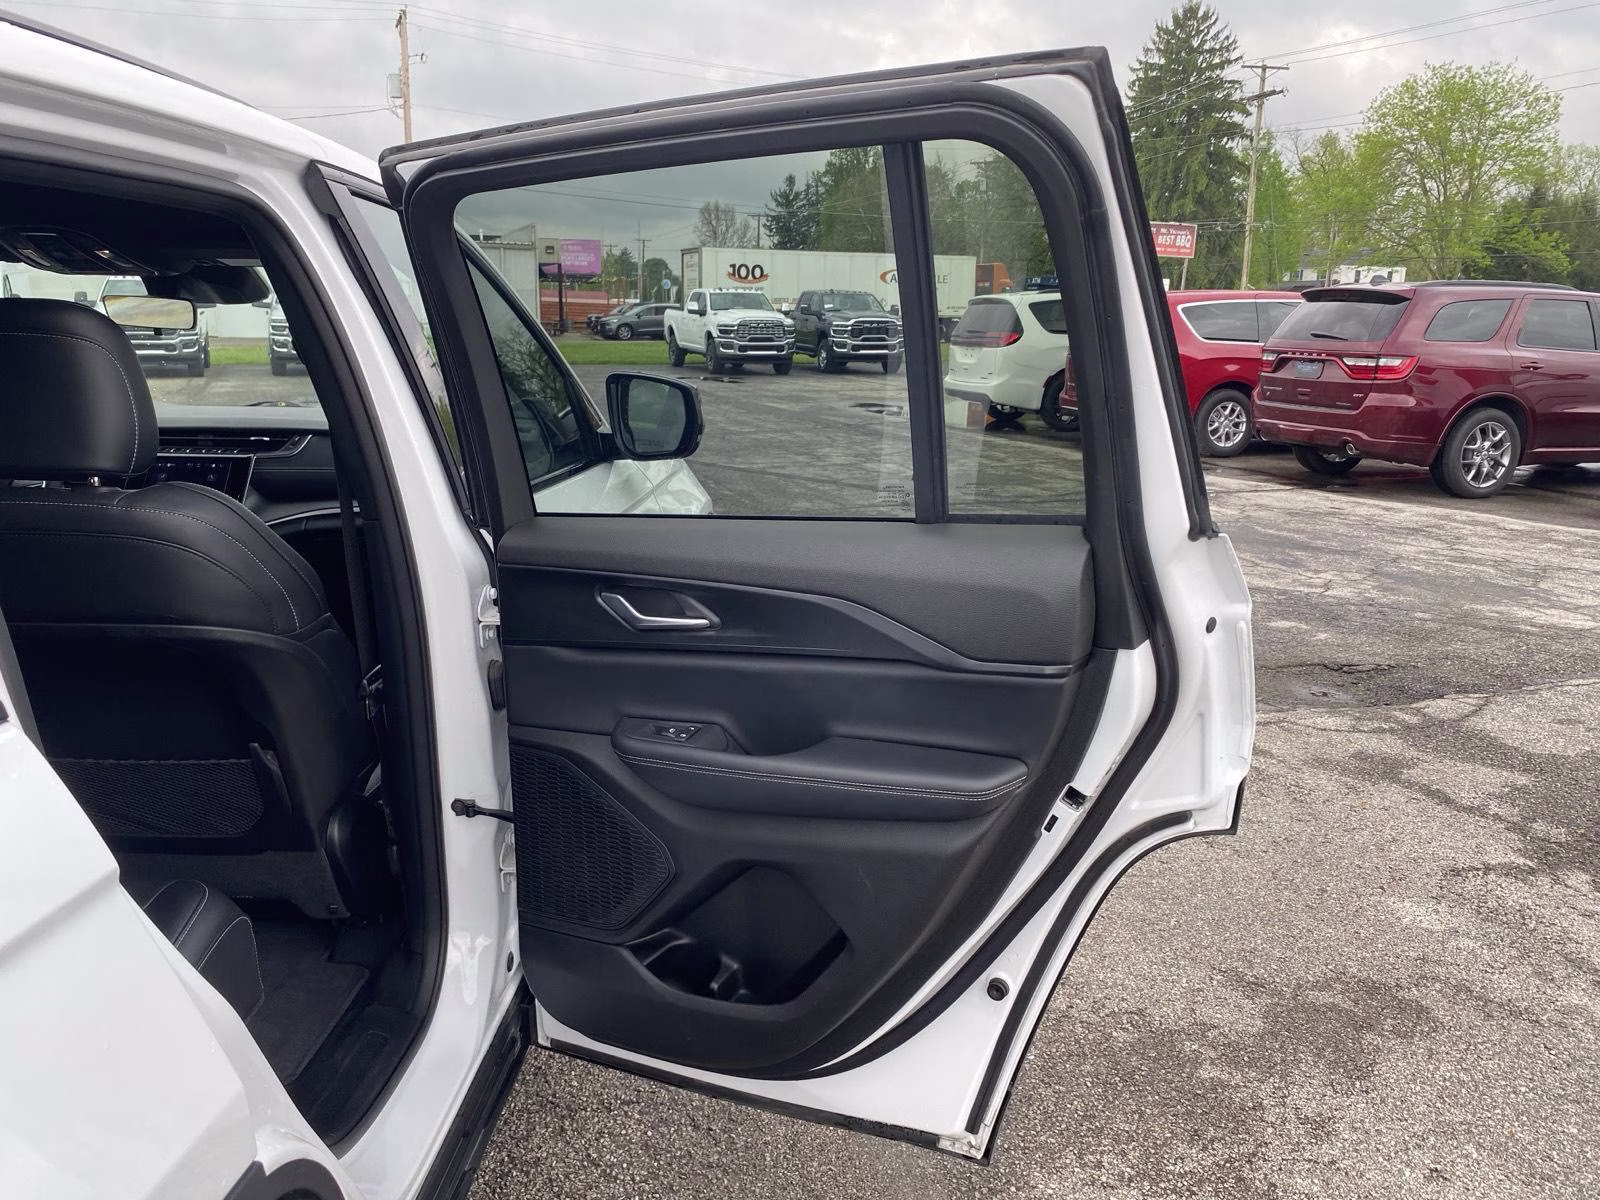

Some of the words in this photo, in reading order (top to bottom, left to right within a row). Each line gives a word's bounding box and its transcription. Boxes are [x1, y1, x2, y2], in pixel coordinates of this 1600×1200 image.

[1157, 235, 1175, 245] BEST
[1175, 235, 1192, 248] BBQ
[729, 263, 765, 280] 100
